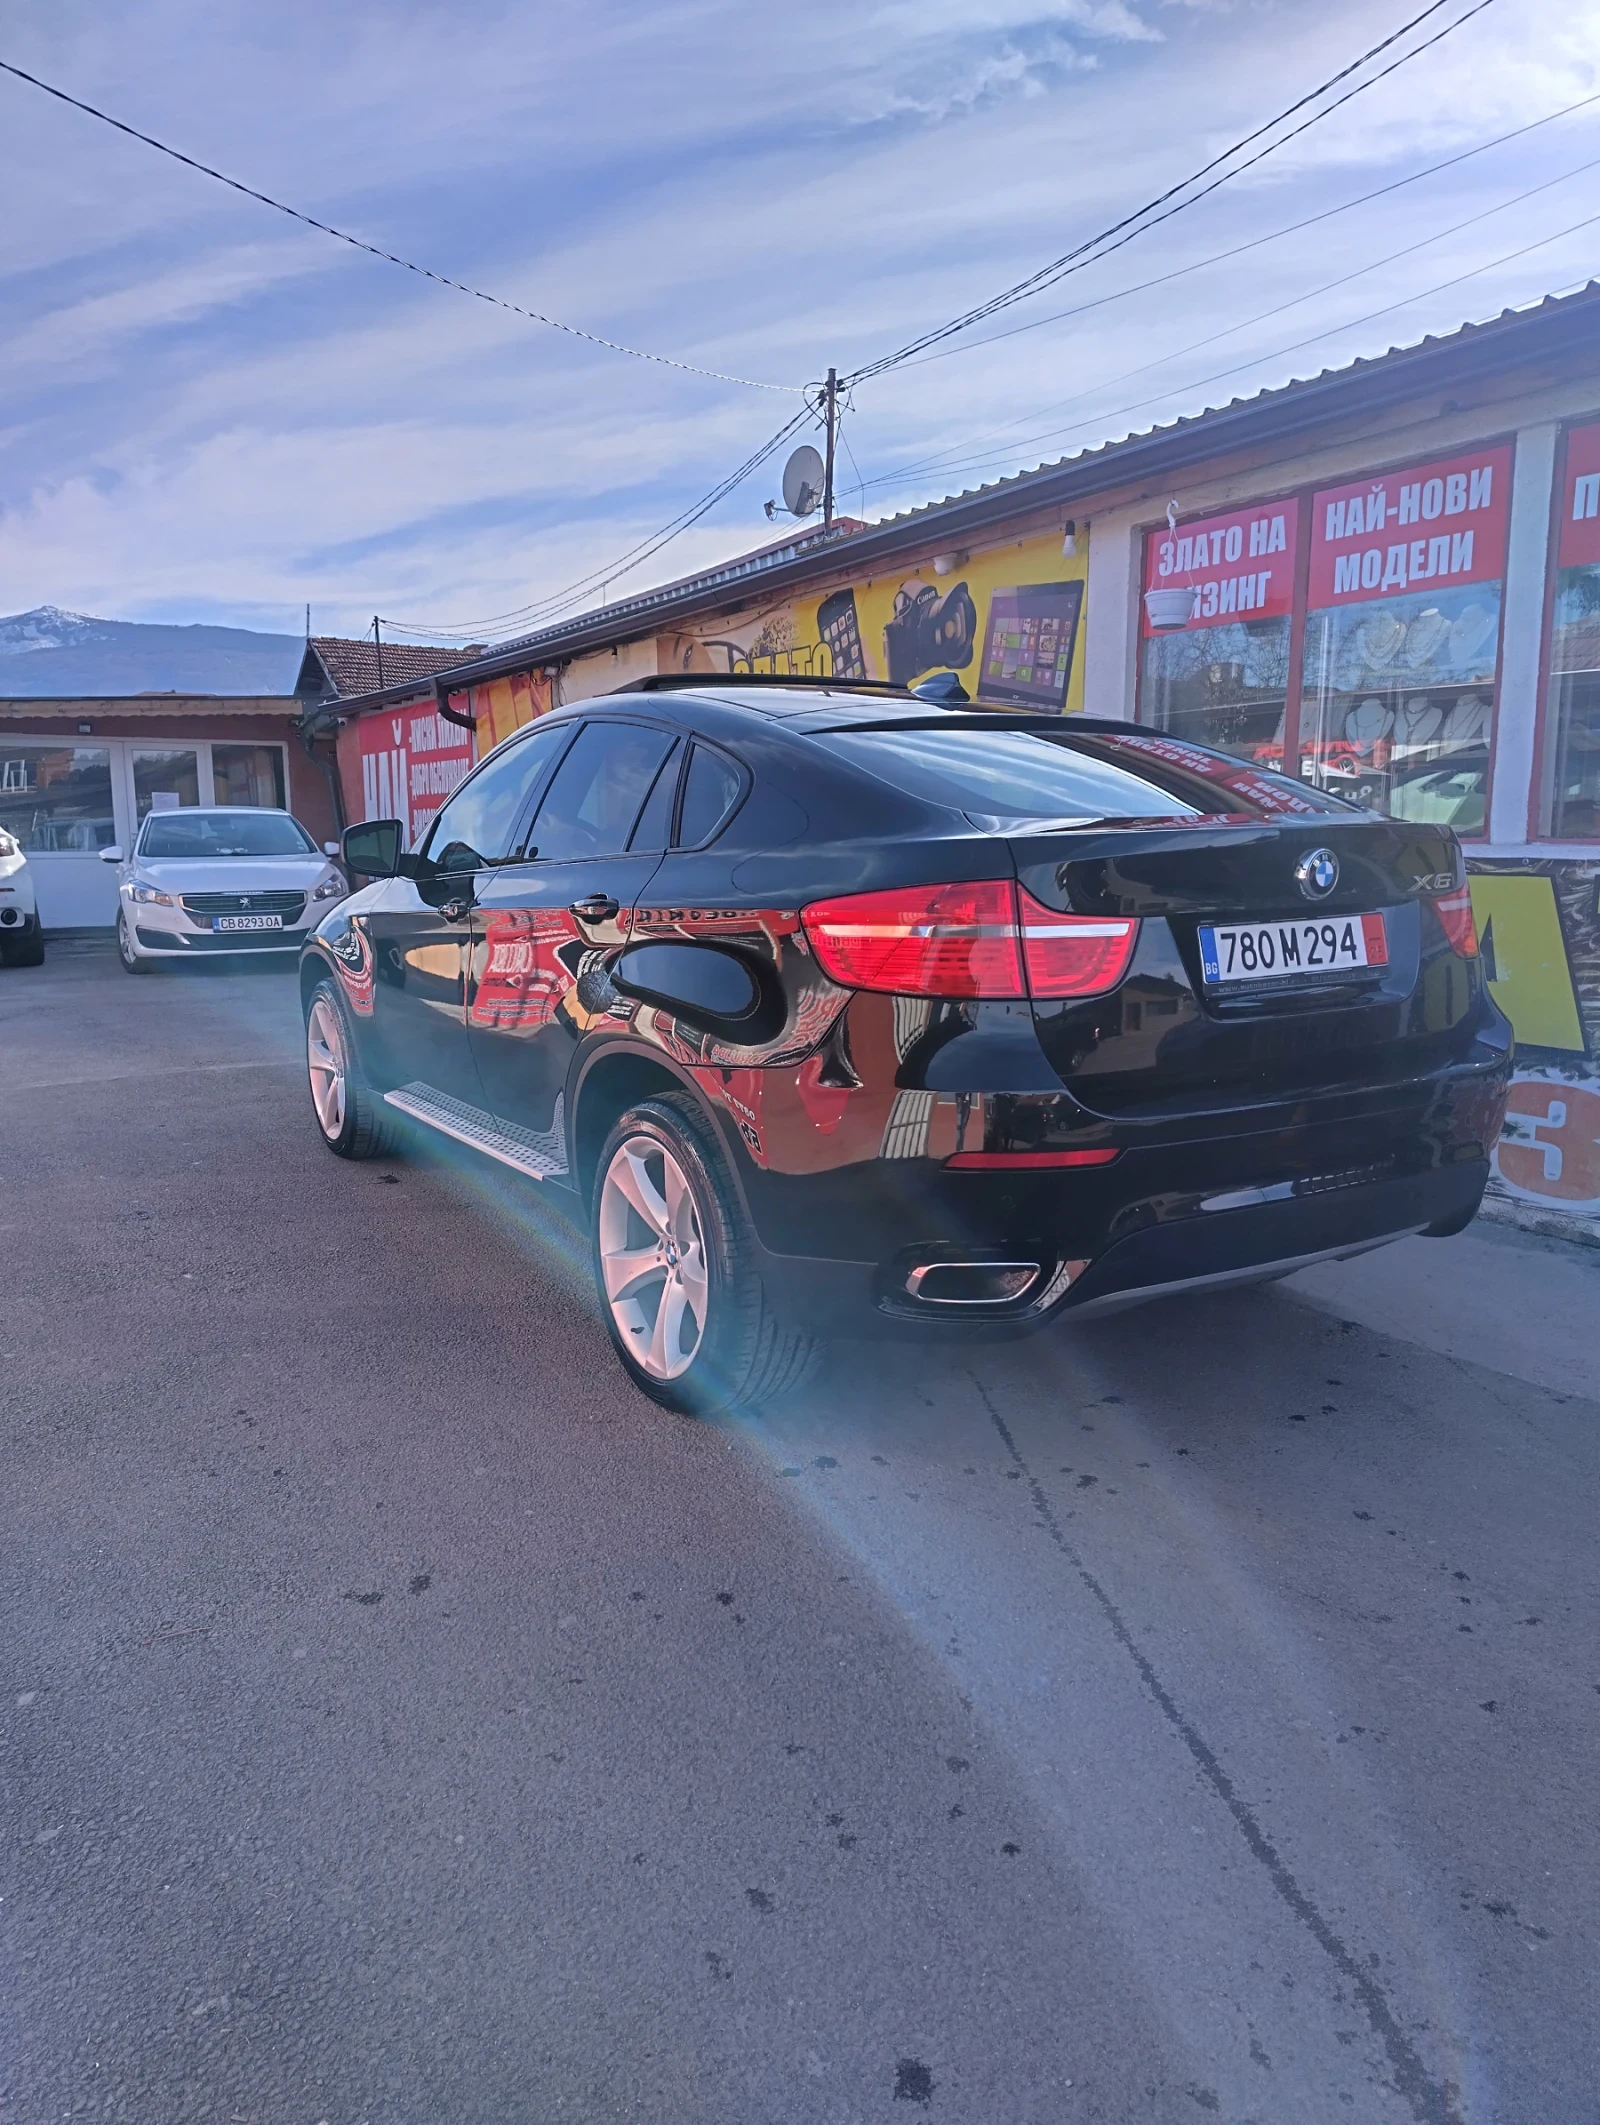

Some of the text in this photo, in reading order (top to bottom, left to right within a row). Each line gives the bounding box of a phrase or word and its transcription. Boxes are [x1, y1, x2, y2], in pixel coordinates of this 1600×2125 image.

[1325, 465, 1493, 541] НАЙ-НОВИ
[1158, 515, 1287, 577] ЗЛАТО НА
[1333, 530, 1474, 594] МОДЕЛИ
[917, 589, 937, 605] Canon
[1187, 571, 1272, 619] ИЗИНГ
[1407, 873, 1453, 892] X6
[220, 918, 236, 929] CB
[237, 917, 264, 928] 8293
[1205, 962, 1219, 975] BG
[1220, 930, 1276, 973] 780
[1279, 927, 1302, 967] M
[1303, 922, 1358, 965] 294
